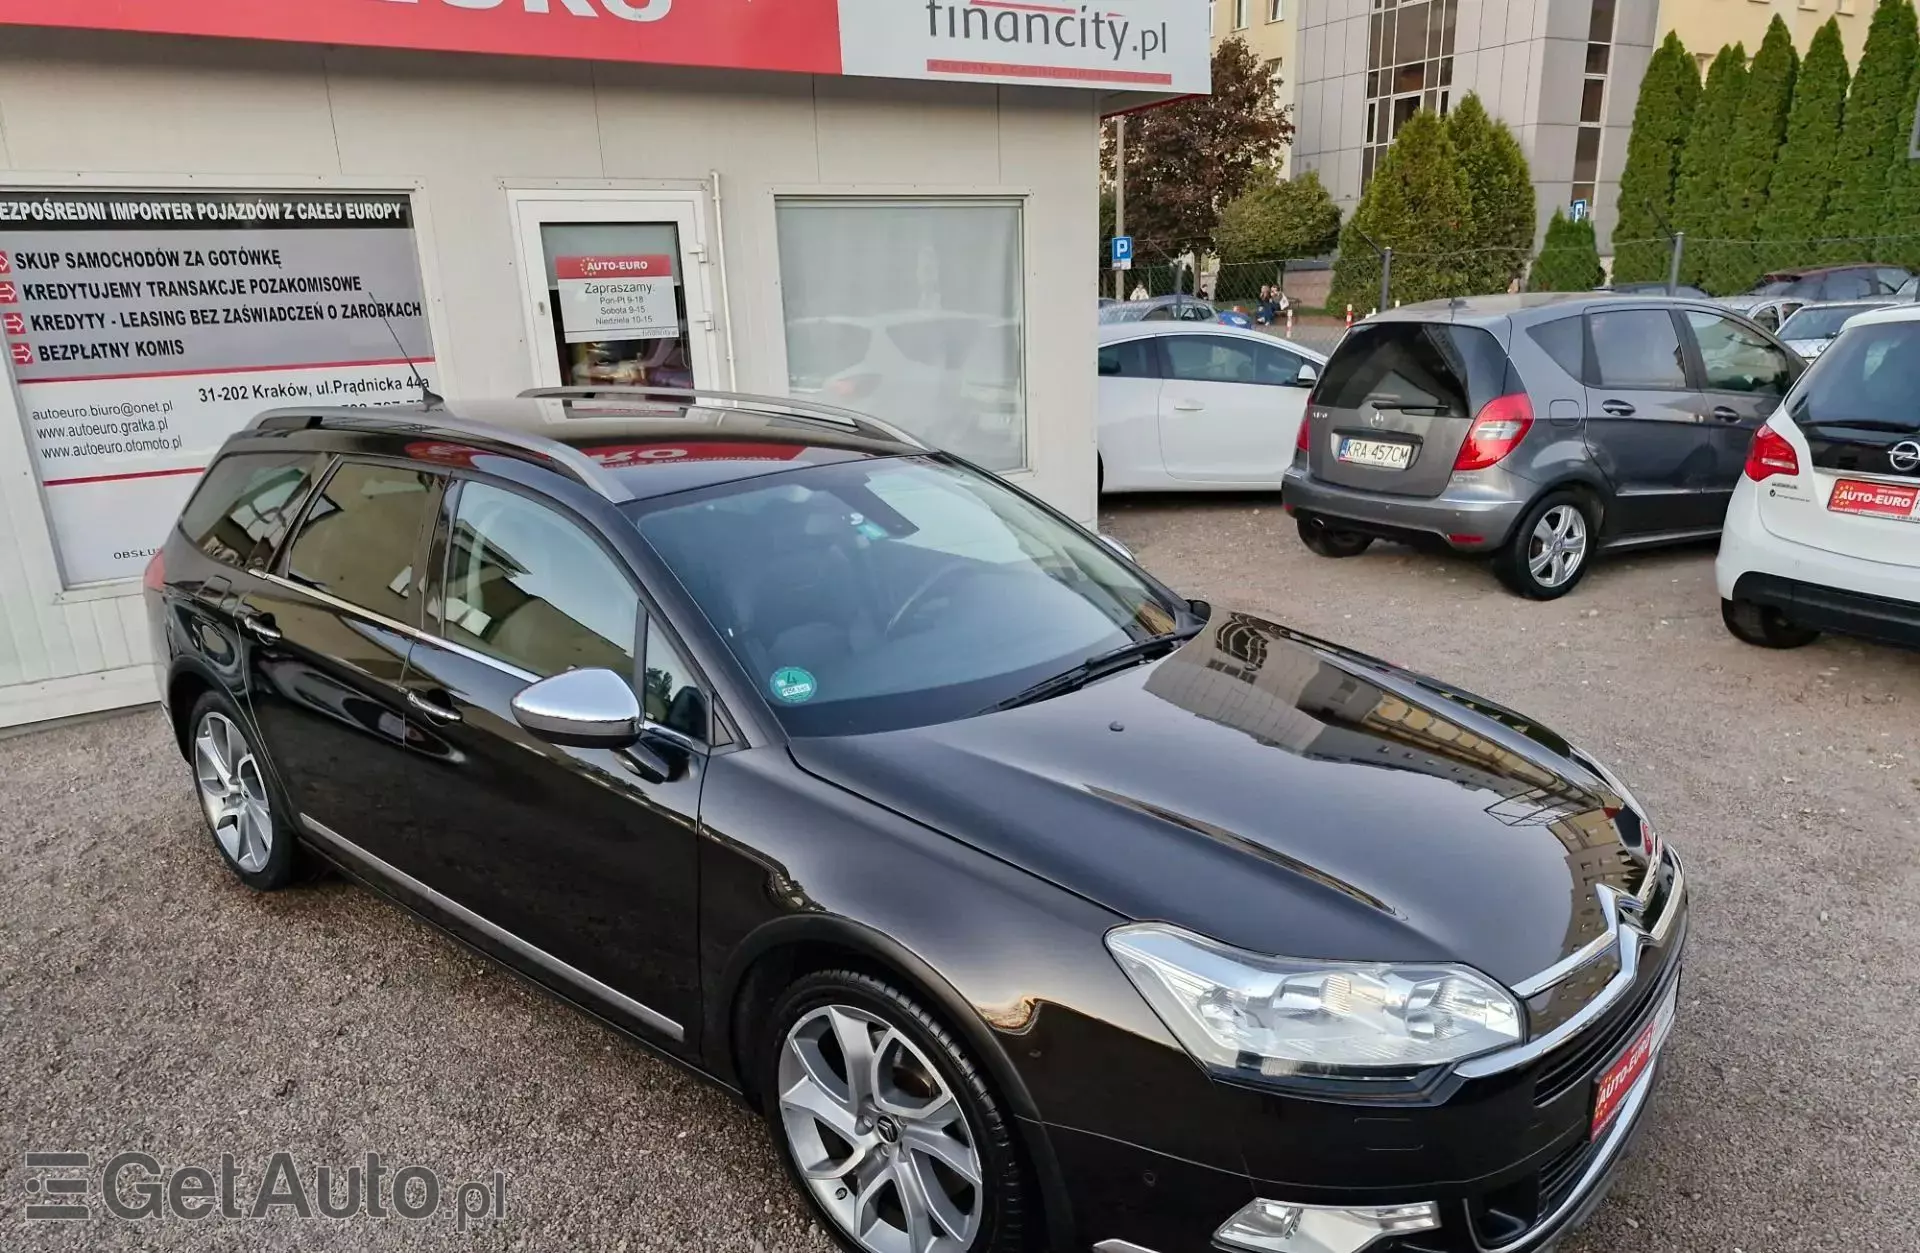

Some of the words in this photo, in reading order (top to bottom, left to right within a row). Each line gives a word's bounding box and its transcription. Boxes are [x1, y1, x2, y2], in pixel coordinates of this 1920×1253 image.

[926, 0, 1167, 60] financity.pl
[0, 197, 106, 221] EZPOŚREDNI
[110, 203, 194, 221] IMPORTER
[196, 199, 280, 220] POJAZDÓW
[283, 203, 295, 220] Z
[297, 203, 343, 220] CAŁEJ
[346, 203, 401, 219] EUROPY
[15, 252, 60, 269] SKUP
[66, 248, 180, 269] SAMOCHODÓW
[183, 251, 205, 267] ZA
[208, 247, 282, 269] GOTÓWKĘ
[1116, 240, 1128, 257] P
[587, 261, 648, 271] AUTO-EURO
[22, 282, 142, 301] KREDYTUJEMY
[146, 279, 246, 298] TRANSAKCJE
[249, 276, 362, 295] POZAKOMISOWE
[30, 313, 105, 332] KREDYTY
[120, 310, 186, 328] LEASING
[190, 308, 220, 325] BEZ
[223, 302, 324, 324] ZAŚWIADCZEŃ
[327, 305, 338, 320] O
[340, 302, 422, 319] ZAROBKACH
[600, 307, 627, 315] Sobota
[628, 306, 646, 314] 9-15
[38, 343, 130, 362] BEZPŁATNY
[134, 339, 185, 356] KOMIS
[198, 385, 249, 403] 31-202
[252, 382, 312, 399] Kraków,
[316, 377, 403, 397] ul.Prądnicka
[406, 375, 430, 388] 44a
[32, 400, 174, 420] autoeuro.biuro@onet.pl
[36, 416, 169, 440] www.autoeuro.gratka.pl
[41, 435, 183, 459] www.autoeuro.otomoto.pl
[1346, 441, 1367, 458] KRA
[1371, 444, 1410, 462] 457CM
[1839, 490, 1911, 508] AUTO-EURO
[113, 548, 156, 560] OBSŁU
